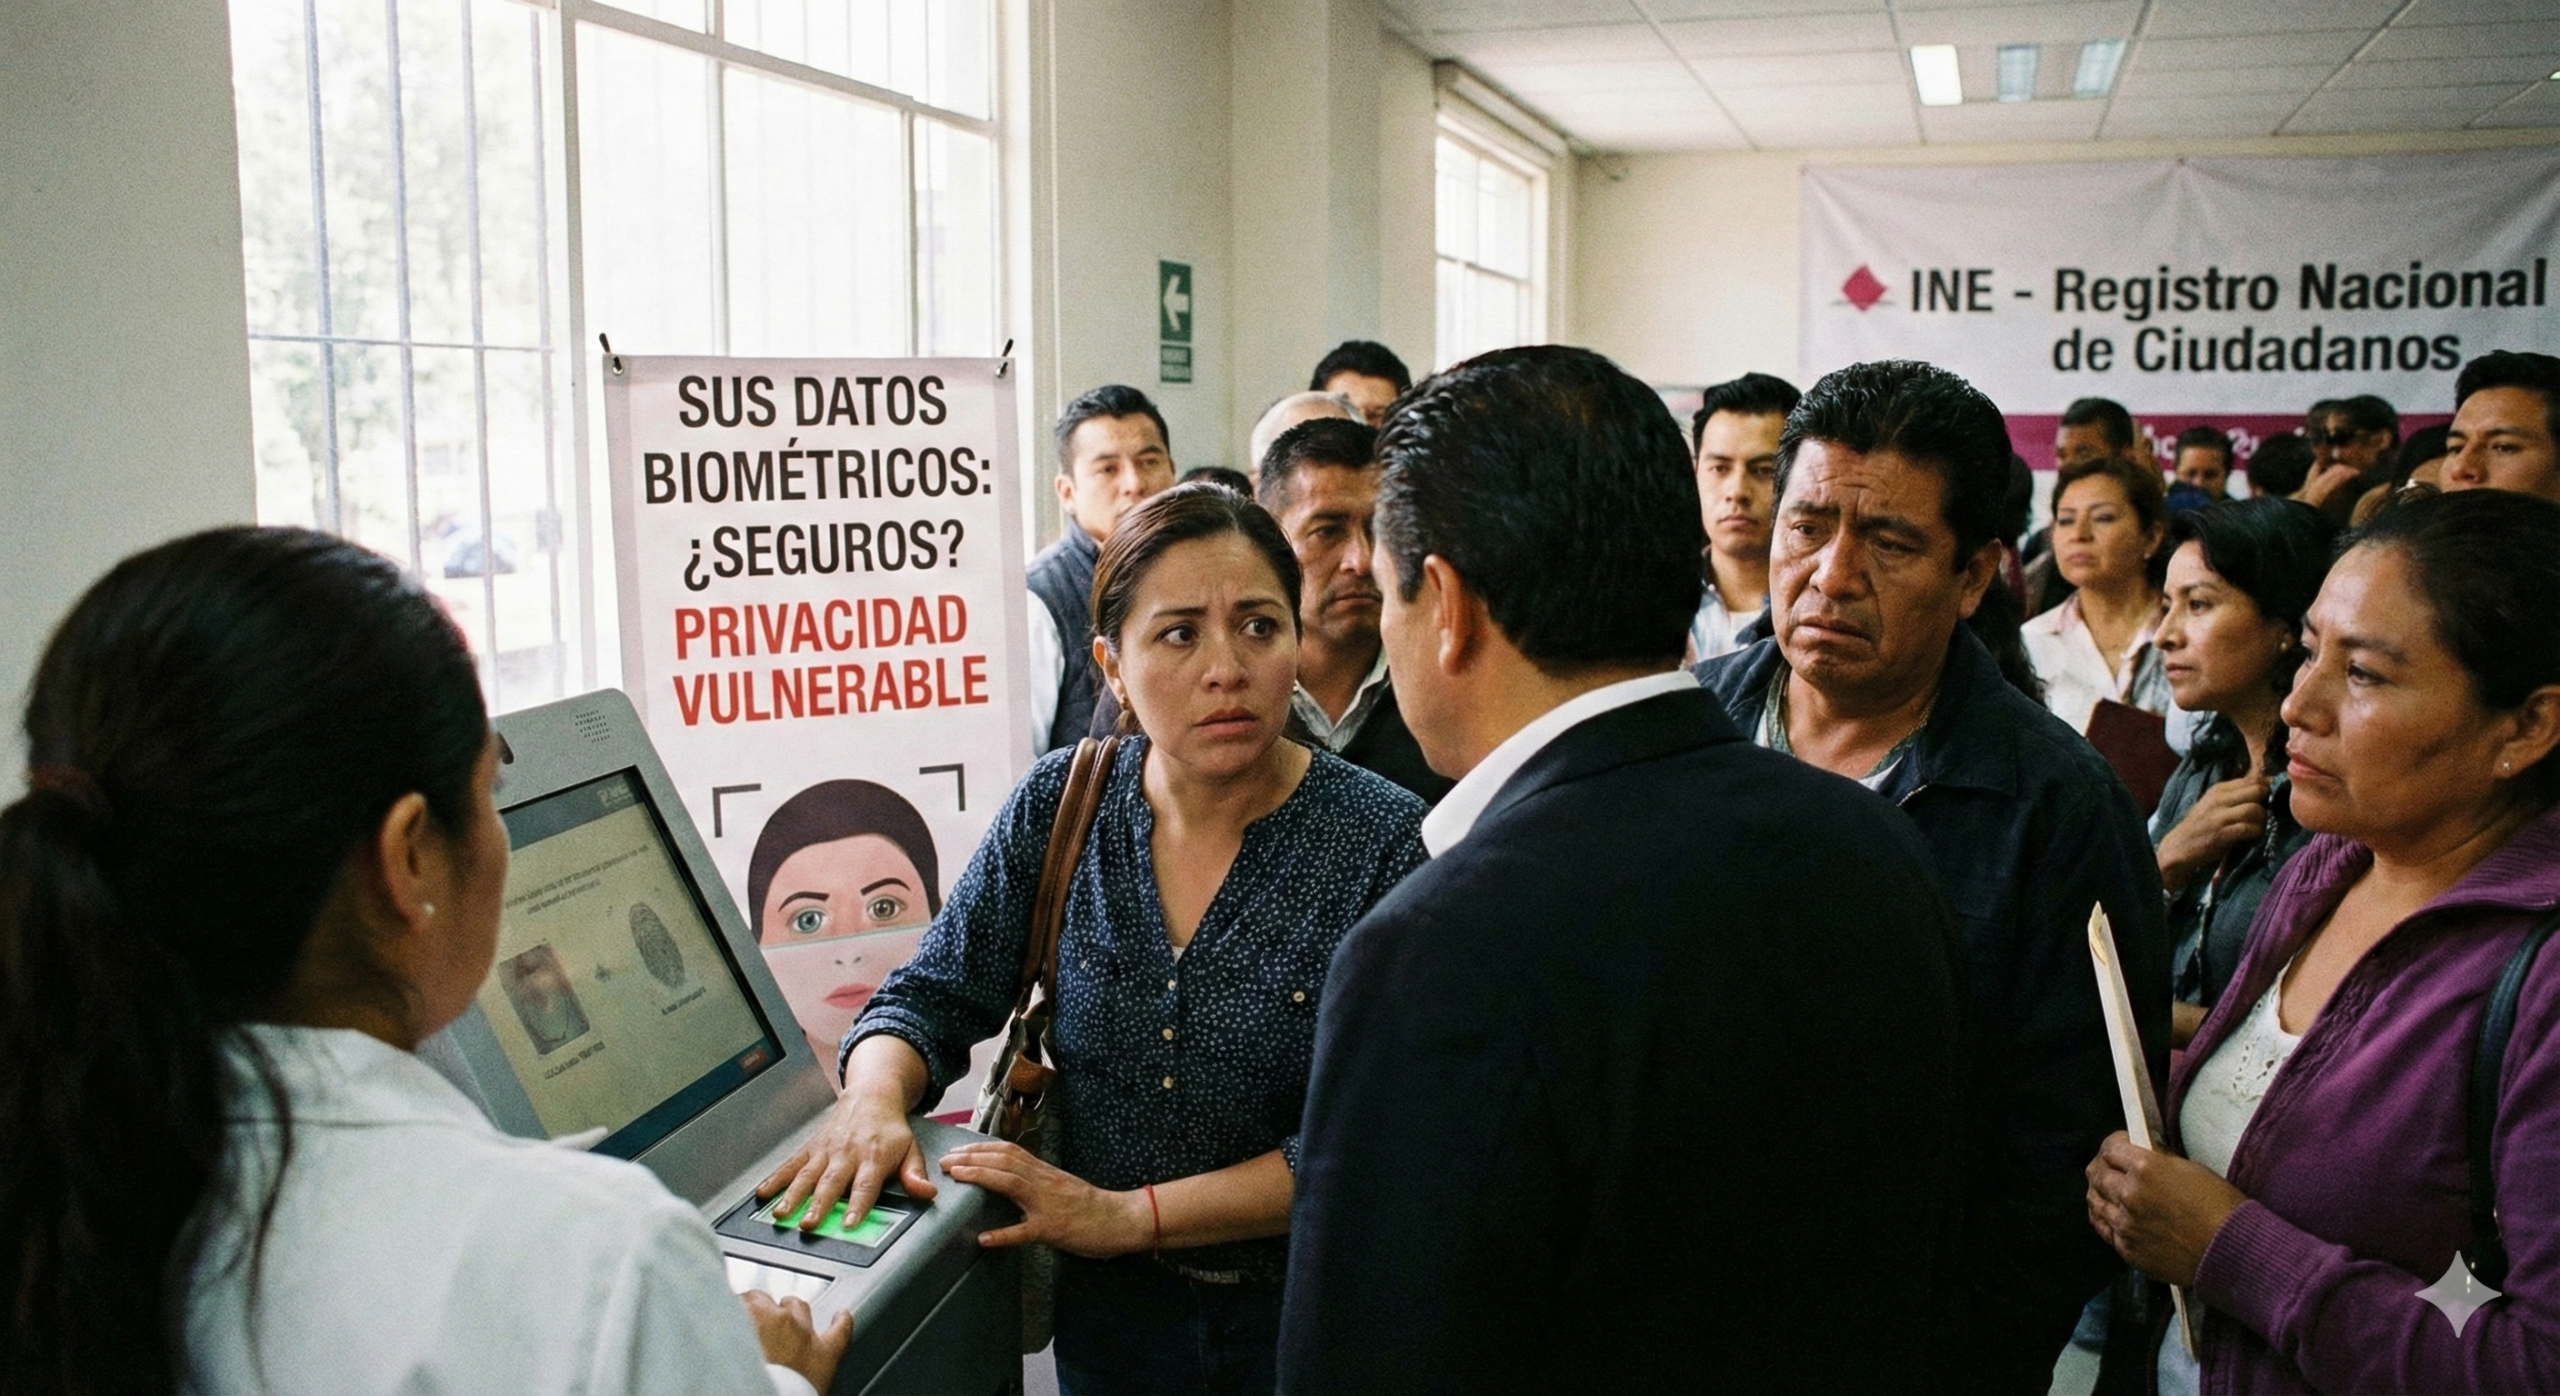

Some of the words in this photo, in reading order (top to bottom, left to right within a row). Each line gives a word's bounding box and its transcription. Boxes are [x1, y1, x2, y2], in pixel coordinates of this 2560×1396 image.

[1912, 268, 1993, 312] INE
[2014, 290, 2033, 298] -
[2055, 265, 2280, 321] Registro
[2299, 257, 2547, 310] Nacional
[2053, 327, 2114, 372] de
[2135, 324, 2461, 372] Ciudadanos
[678, 375, 777, 427] SUS
[794, 375, 947, 426] DATOS
[643, 437, 992, 504] BIOMÉTRICOS:
[683, 519, 965, 591] ¿SEGUROS?
[675, 594, 968, 660] PRIVACIDAD
[672, 655, 989, 727] VULNERABLE
